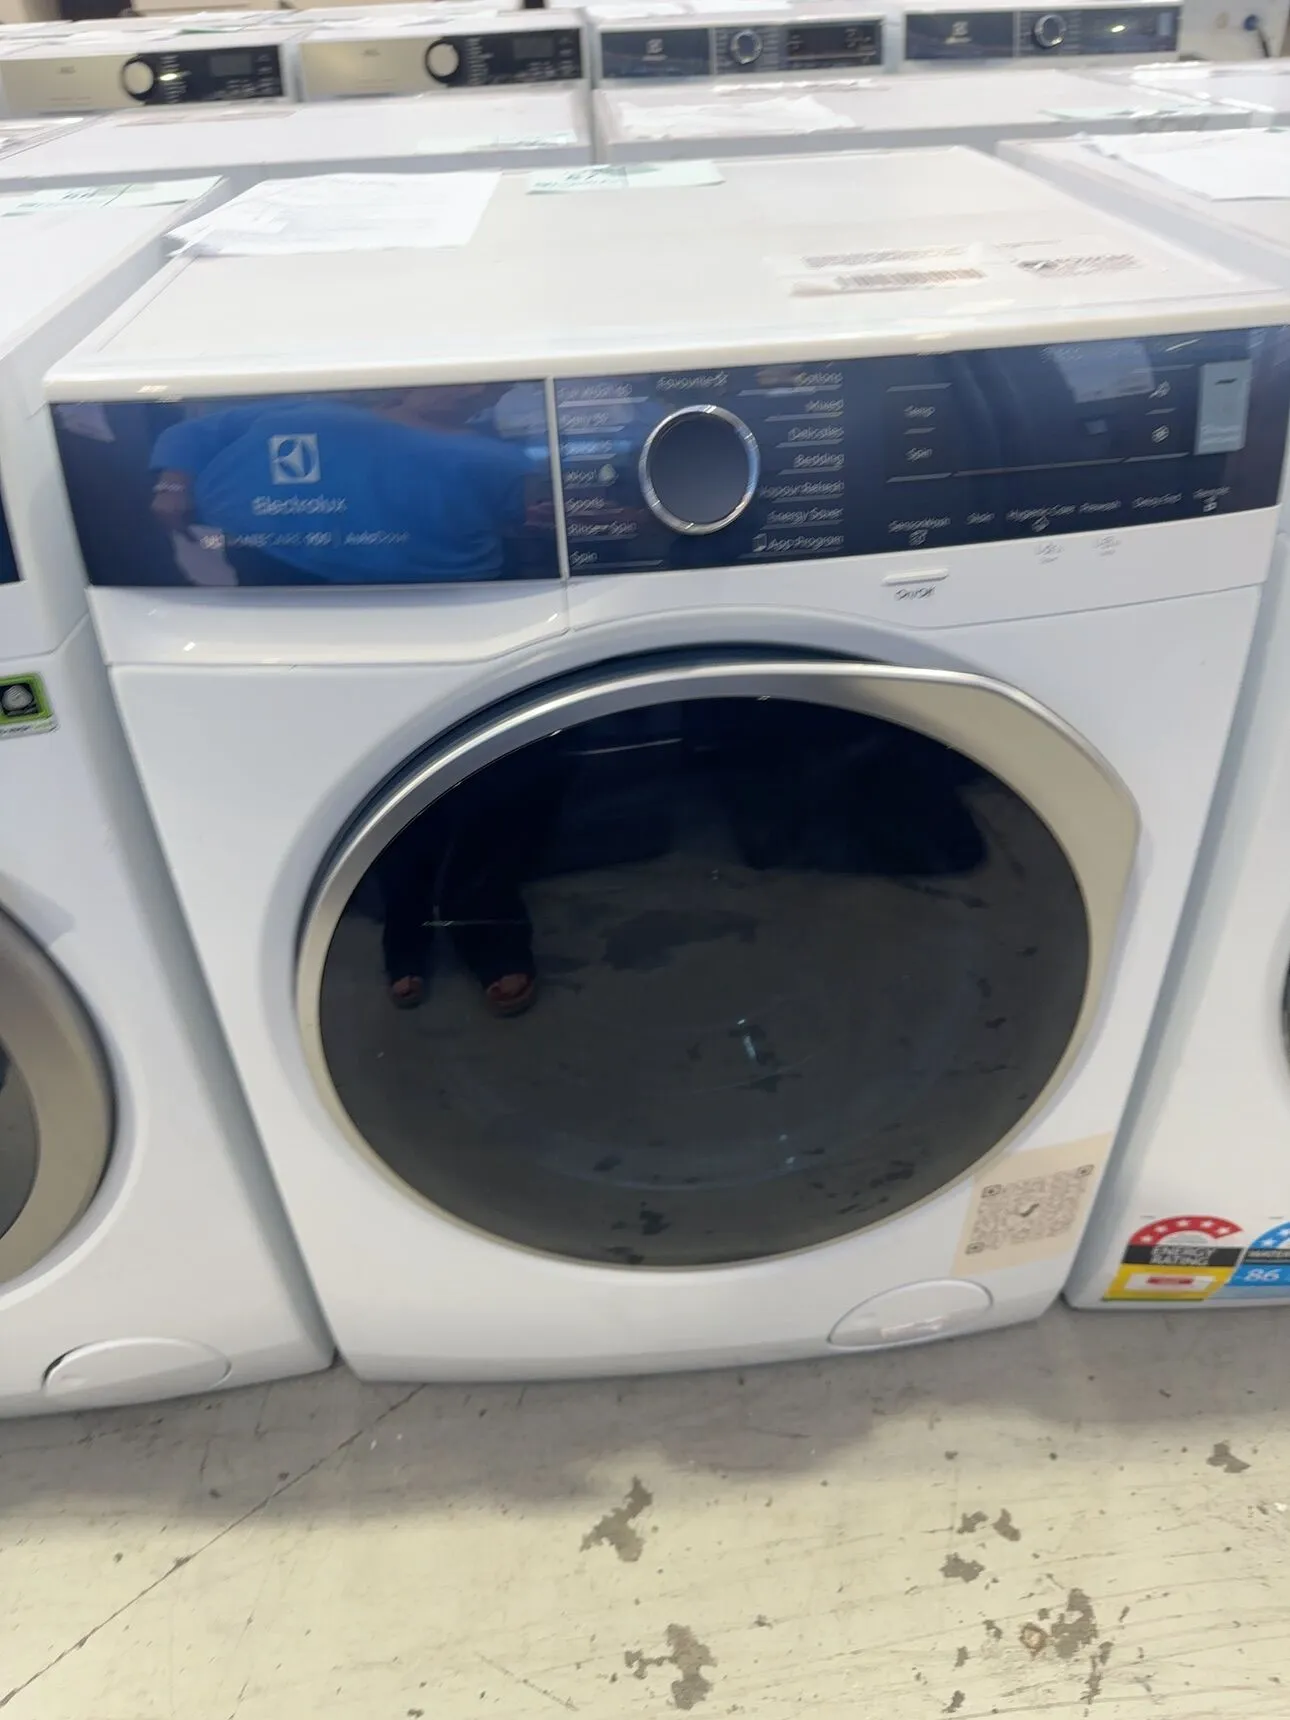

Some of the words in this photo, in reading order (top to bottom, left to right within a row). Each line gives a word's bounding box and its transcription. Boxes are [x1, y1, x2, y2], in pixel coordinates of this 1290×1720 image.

[806, 399, 844, 413] Mixed
[789, 426, 844, 441] Delicates
[794, 452, 845, 468] Bedding
[252, 494, 349, 517] Electrolux
[768, 508, 810, 524] Energy
[811, 506, 844, 521] Saver
[768, 538, 793, 552] App
[794, 533, 845, 551] Program
[569, 550, 598, 566] Spin
[1245, 1268, 1282, 1283] 86
